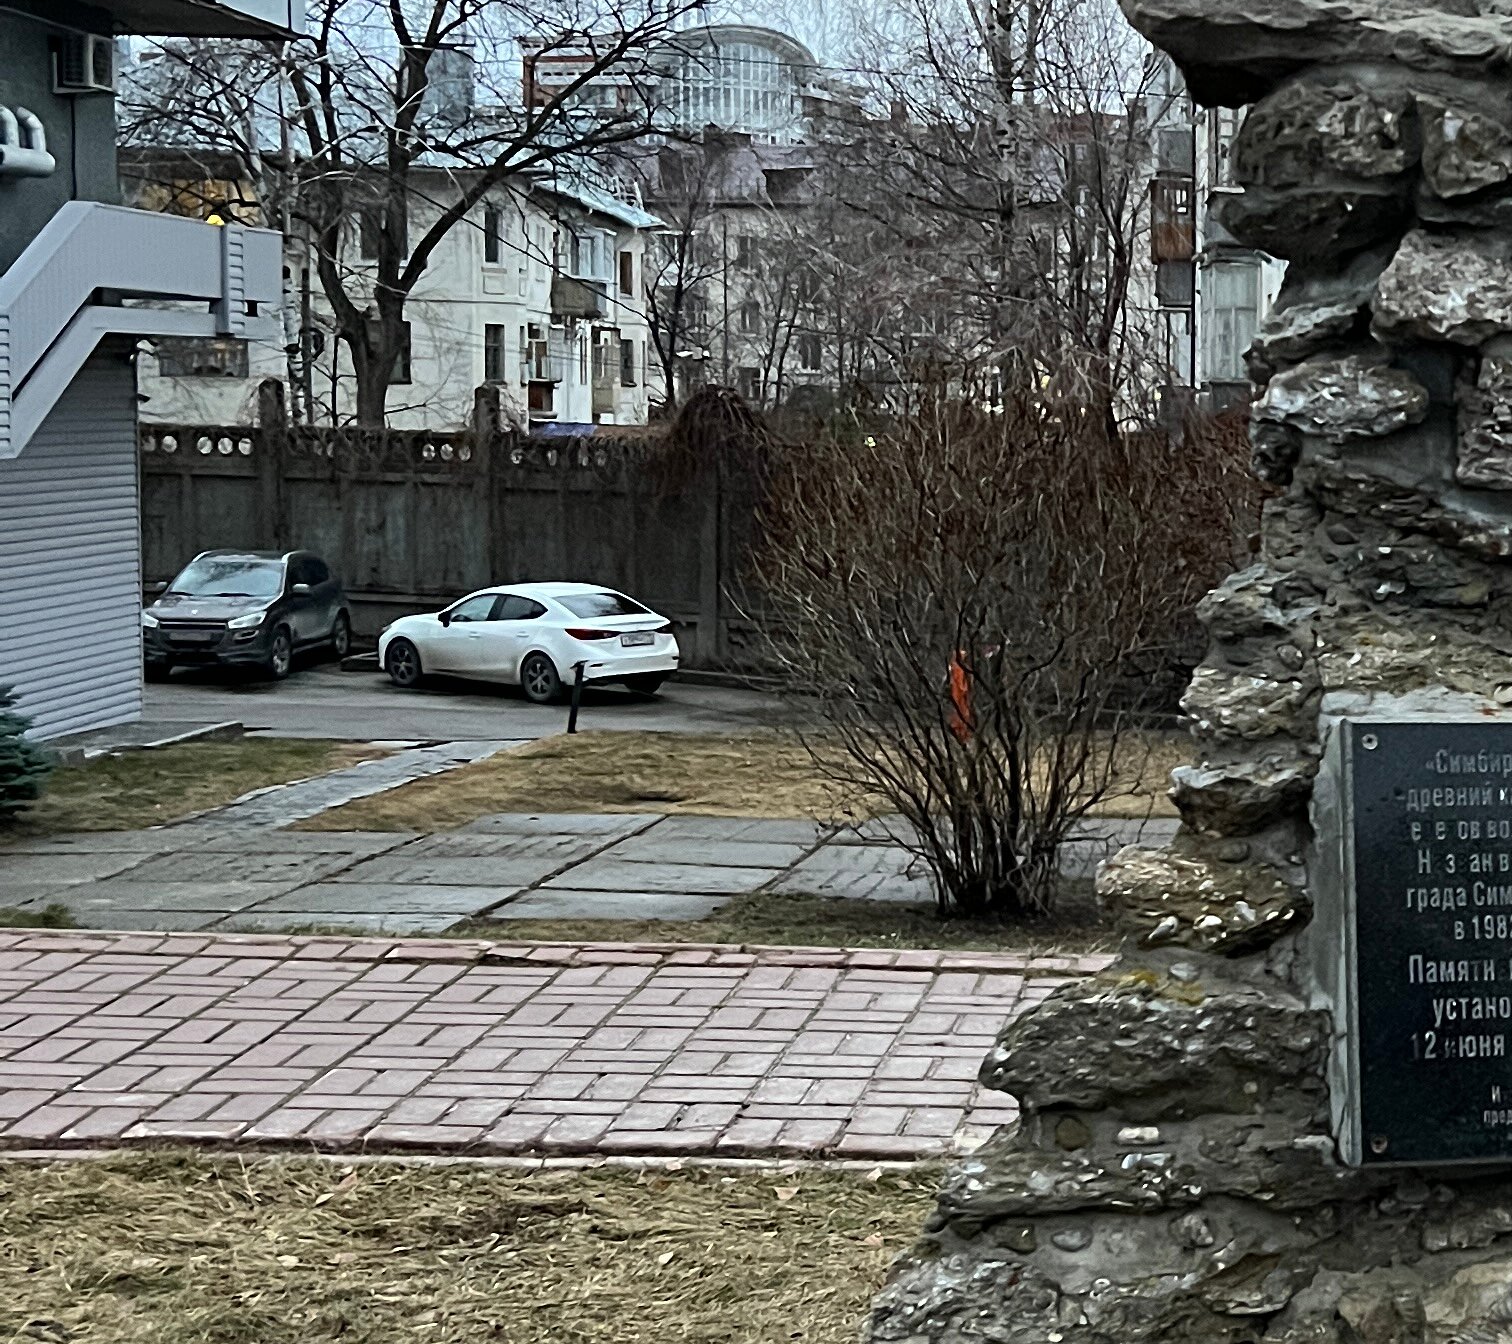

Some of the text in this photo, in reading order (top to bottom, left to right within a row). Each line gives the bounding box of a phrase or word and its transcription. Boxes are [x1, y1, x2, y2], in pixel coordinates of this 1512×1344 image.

[1417, 847, 1493, 874] Нзан
[1499, 852, 1510, 872] в
[1406, 886, 1467, 913] града
[1453, 919, 1465, 941] в
